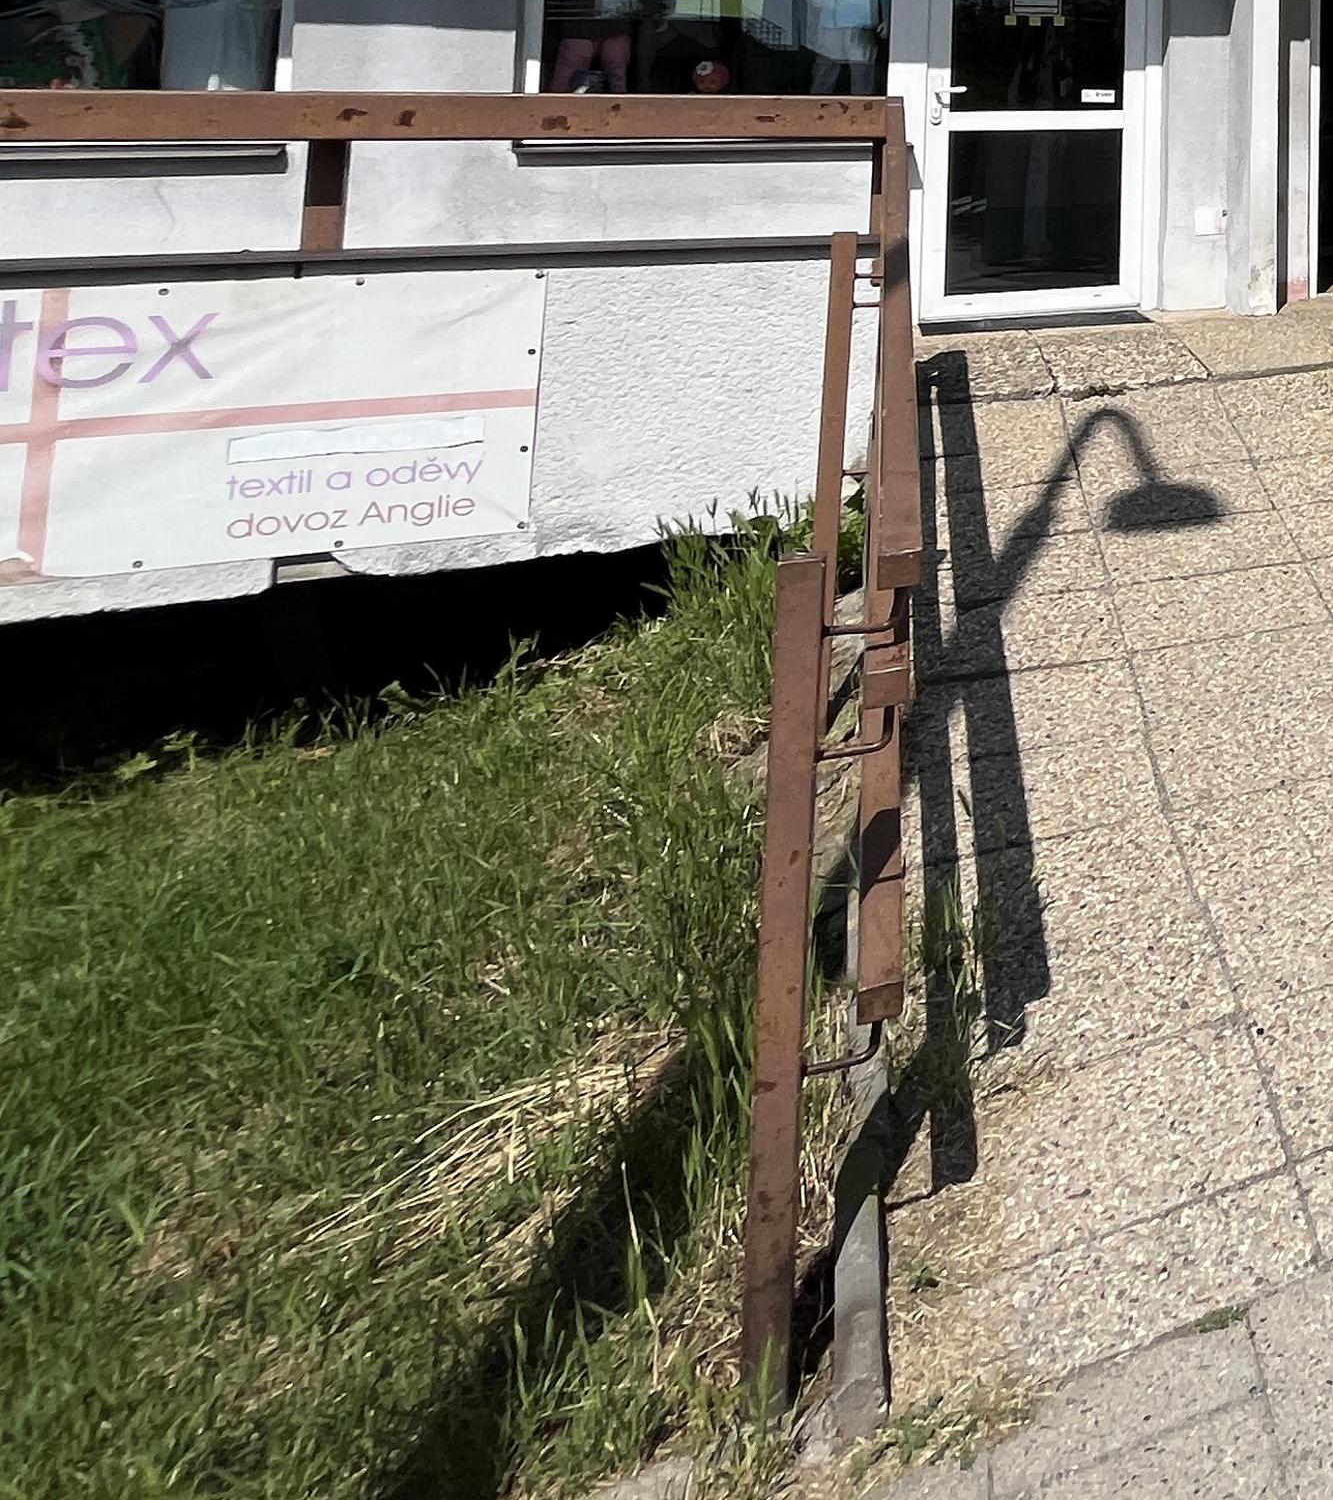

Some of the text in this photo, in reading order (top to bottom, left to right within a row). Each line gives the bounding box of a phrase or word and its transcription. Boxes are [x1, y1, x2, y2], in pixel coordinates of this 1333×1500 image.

[0, 300, 220, 392] tex
[226, 455, 484, 500] textil a oděvy
[226, 494, 476, 539] dovoz Anglie
